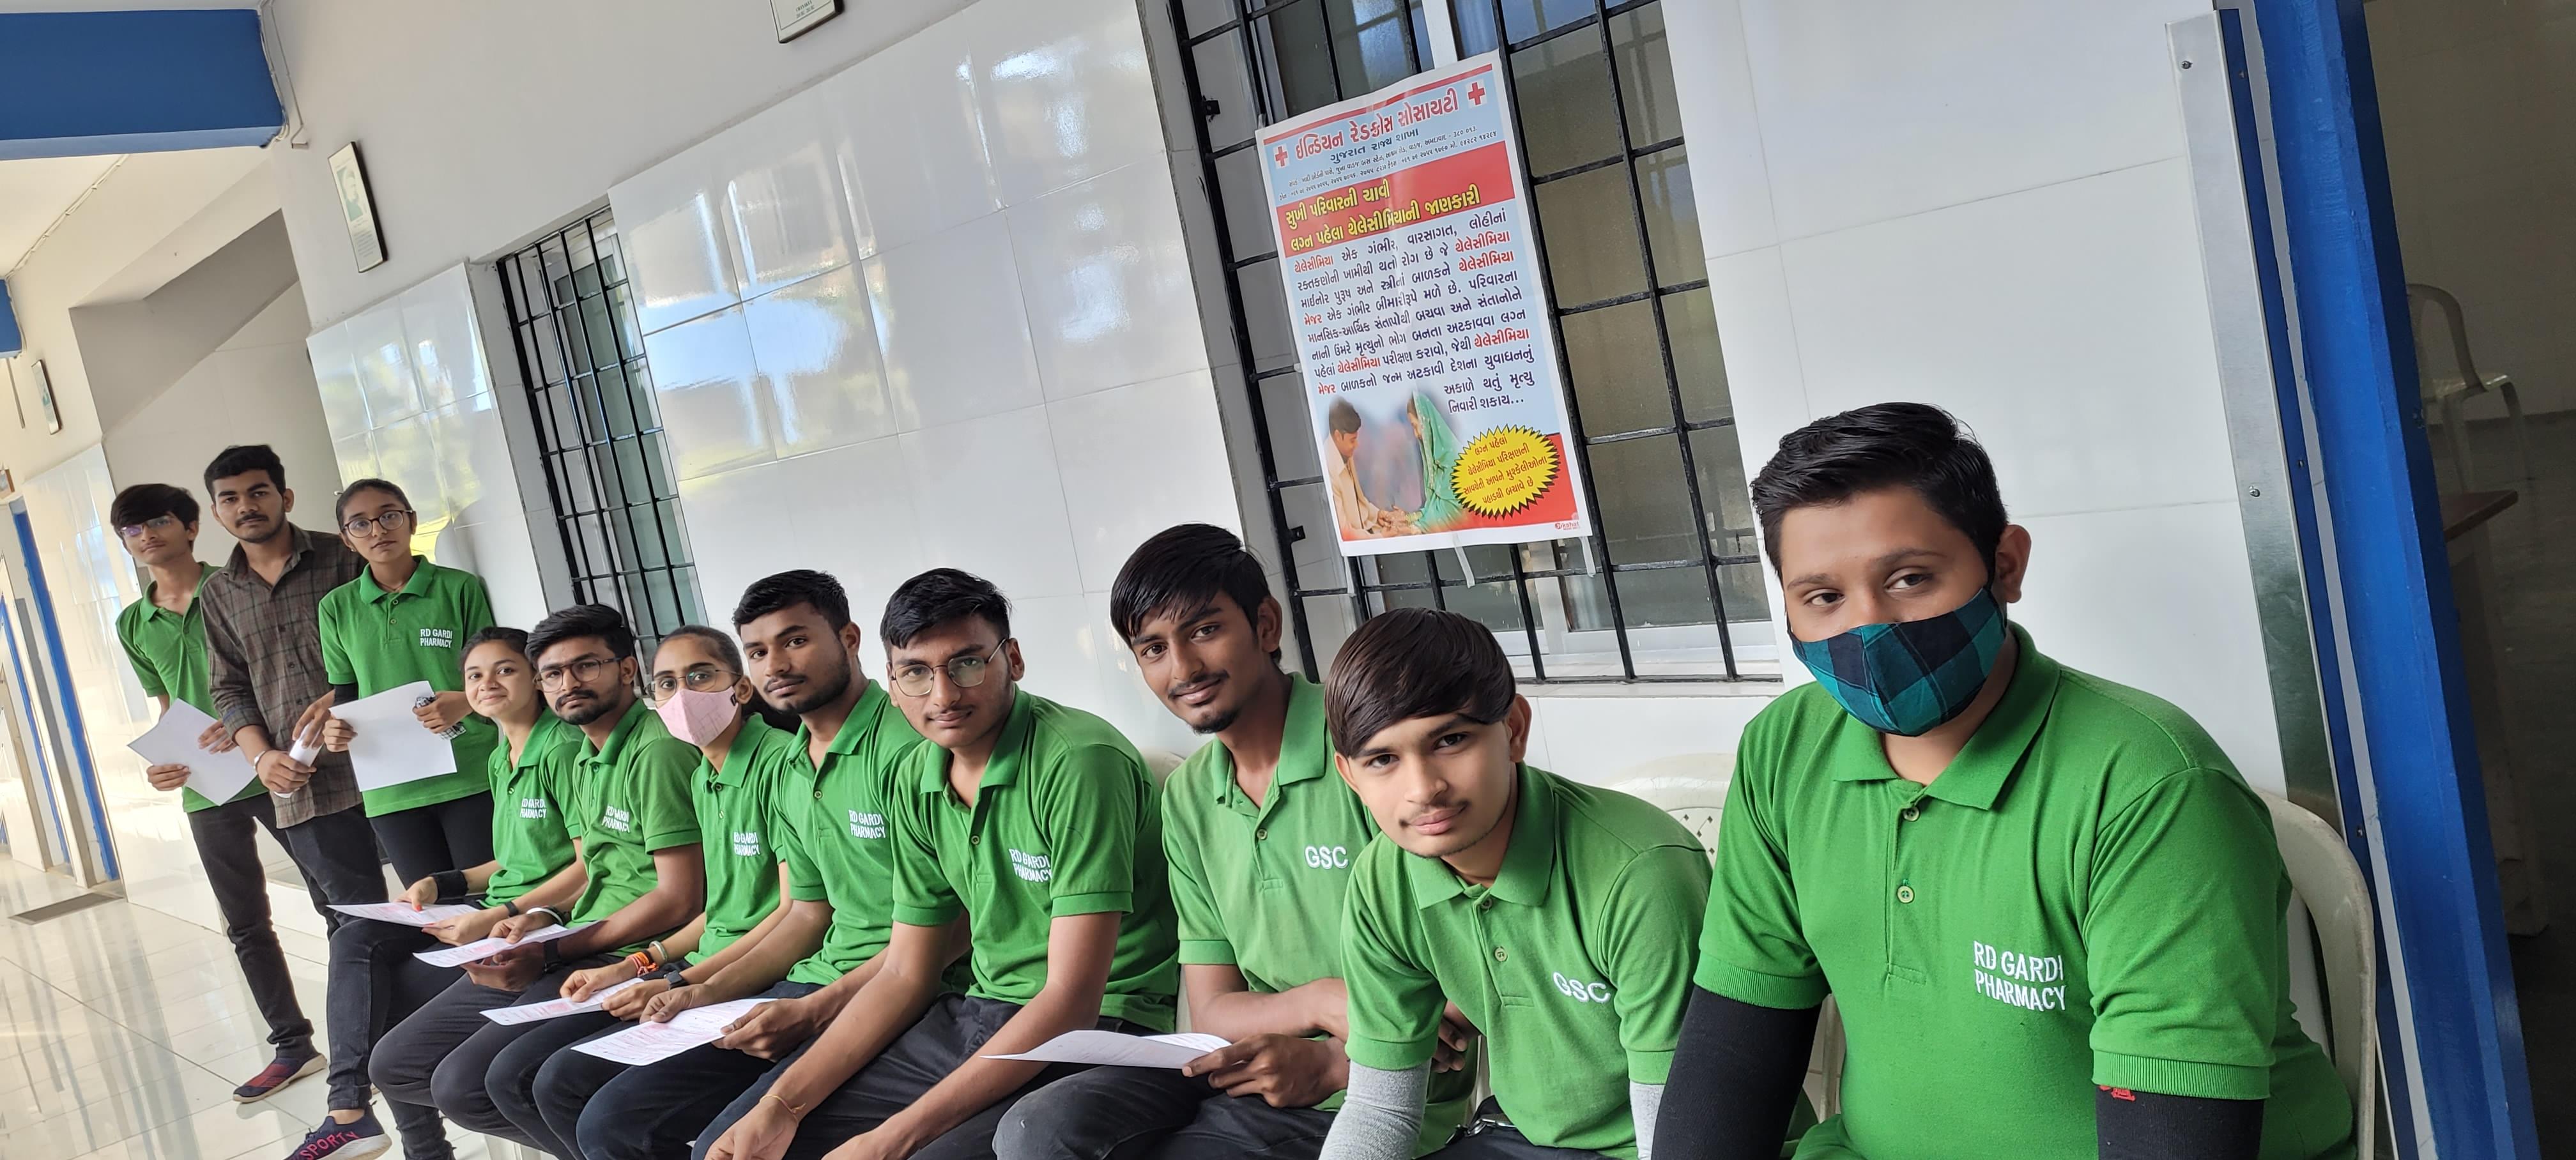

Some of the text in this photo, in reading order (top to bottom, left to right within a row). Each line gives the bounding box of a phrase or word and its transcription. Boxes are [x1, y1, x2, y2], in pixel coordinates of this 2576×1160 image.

[1398, 88, 1459, 127] સોસાયટી
[1330, 128, 1419, 164] ગુજરાત રાજ્ય શાખા
[1425, 134, 1447, 146] અમદાવાદ
[1285, 178, 1390, 230] સુખી પરિવારની ચાવી
[1291, 183, 1481, 252] લગ્ન પહેલા થેલેસીમિયાની જાણકારી
[1294, 208, 1506, 273] થેલેસીમિયા એક ગંભીર, વારસાગત, લોહીનાં
[1297, 231, 1510, 291] રક્તકણોની ખામીથી થતો રોગ છે જે થેલેસીમિયા
[1356, 280, 1374, 296] અને
[1381, 271, 1406, 290] સ્ત્રીનાં
[1411, 261, 1451, 284] બાળકને
[1459, 250, 1514, 272] થેલેસીમિયા
[1304, 270, 1518, 326] મેજર એક ગંભીર બીમારીરૂપે મળે છે. પરિવારના
[1307, 286, 1522, 344] માનસિક-આર્થિક સંતાપોથી બચવા અને સંતાનોને
[1312, 309, 1526, 361] નાની ઉંમરે મૃત્યુનો ભોગ બનતા અટકાવવા લગ્ન
[1314, 327, 1530, 378] પહેલાં થેલેસીમિયા પરીક્ષણ કરાવો, જેથી થેલેસીમિયા
[1318, 344, 1534, 395] મેજર બાળકનો જન્મ અટકાવી દેશના યુવાધનનું
[1444, 370, 1535, 395] અકાળે થતું મૃત્યુ
[1448, 396, 1478, 414] નિવારી
[1468, 443, 1530, 477] થેલેસીમિયા પરિક્ષણની
[1475, 434, 1508, 455] લગ્ન પહેલાં
[1485, 469, 1505, 486] આપને
[1506, 456, 1547, 480] મુશ્કેલીઓના
[1482, 476, 1534, 504] પહાડથી બચાવે છે
[420, 628, 453, 639] RD GARDI
[420, 637, 452, 648] PHARMACY
[848, 809, 884, 827] RD GARDI
[850, 822, 886, 839] PHARMACY
[1008, 848, 1051, 869] RD GARDI
[1013, 862, 1052, 883] PHARMACY
[1305, 845, 1349, 869] GSC
[1974, 940, 2064, 983] RD GARDI
[1552, 971, 1611, 1004] GSC
[1974, 968, 2067, 1012] PHARMACY
[300, 1131, 358, 1160] SPORTY
